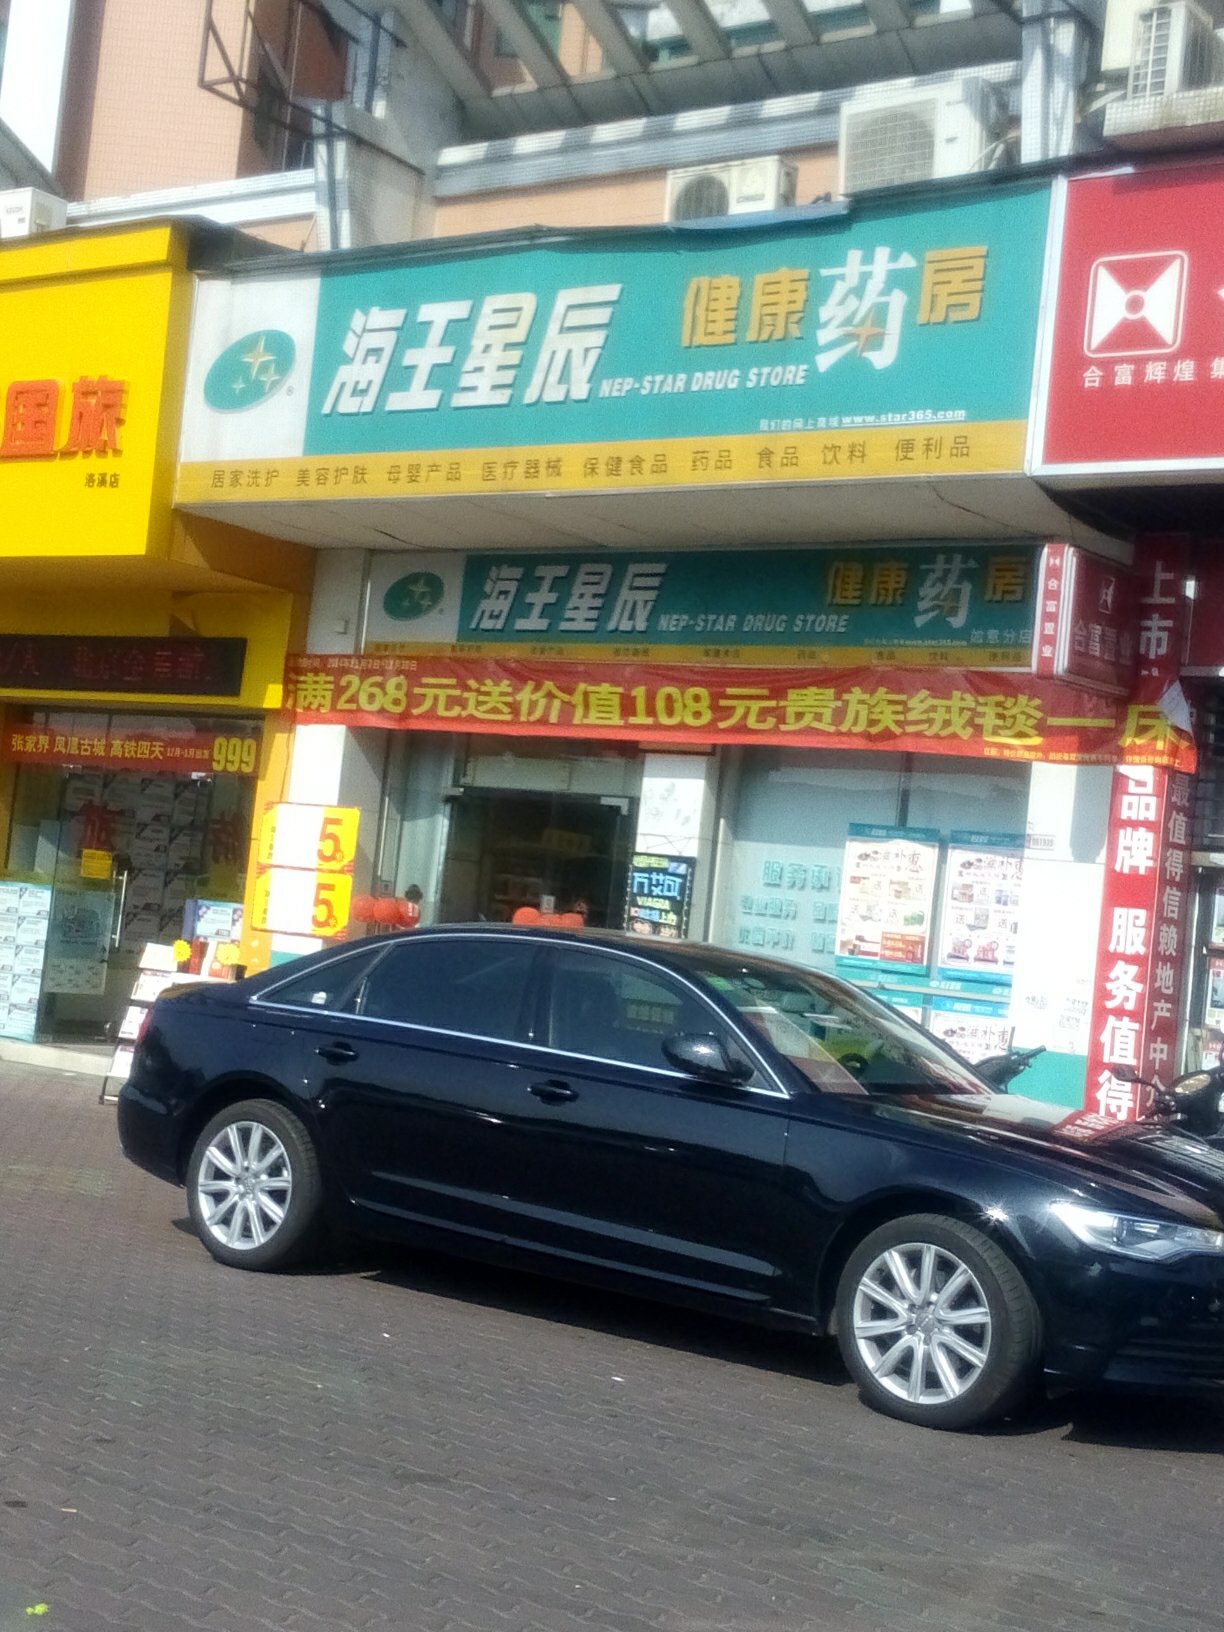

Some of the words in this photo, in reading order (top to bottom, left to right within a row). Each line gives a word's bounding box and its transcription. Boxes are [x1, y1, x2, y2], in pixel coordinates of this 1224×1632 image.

[681, 246, 989, 373] 健康药房
[321, 283, 624, 416] 海王星辰
[599, 373, 688, 398] NEP-STAR
[690, 368, 741, 392] DRUG
[746, 364, 809, 388] STORE
[841, 408, 967, 426] www.star365.com
[212, 469, 280, 489] 居家洗护
[296, 463, 368, 487] 美容护肤
[387, 462, 462, 485] 母婴产品
[482, 457, 563, 482] 医疗器械
[583, 452, 668, 478] 保健食品
[691, 449, 733, 472] 药品
[757, 445, 800, 469] 食品
[821, 440, 867, 465] 饮料
[895, 434, 970, 462] 便利品
[469, 562, 668, 632] 海王星辰
[827, 553, 1030, 628] 健康药房
[1041, 578, 1059, 658] 合富置业
[1139, 560, 1176, 659] 上市
[657, 613, 737, 633] NEP-STAR
[742, 614, 789, 633] DRUG
[792, 614, 850, 633] STORE
[111, 738, 165, 760] 高铁四天
[212, 736, 258, 773] 999
[317, 816, 343, 864] 5
[311, 882, 336, 929] 5
[632, 871, 683, 900] 万艾可
[1095, 907, 1148, 1123] 服务值得
